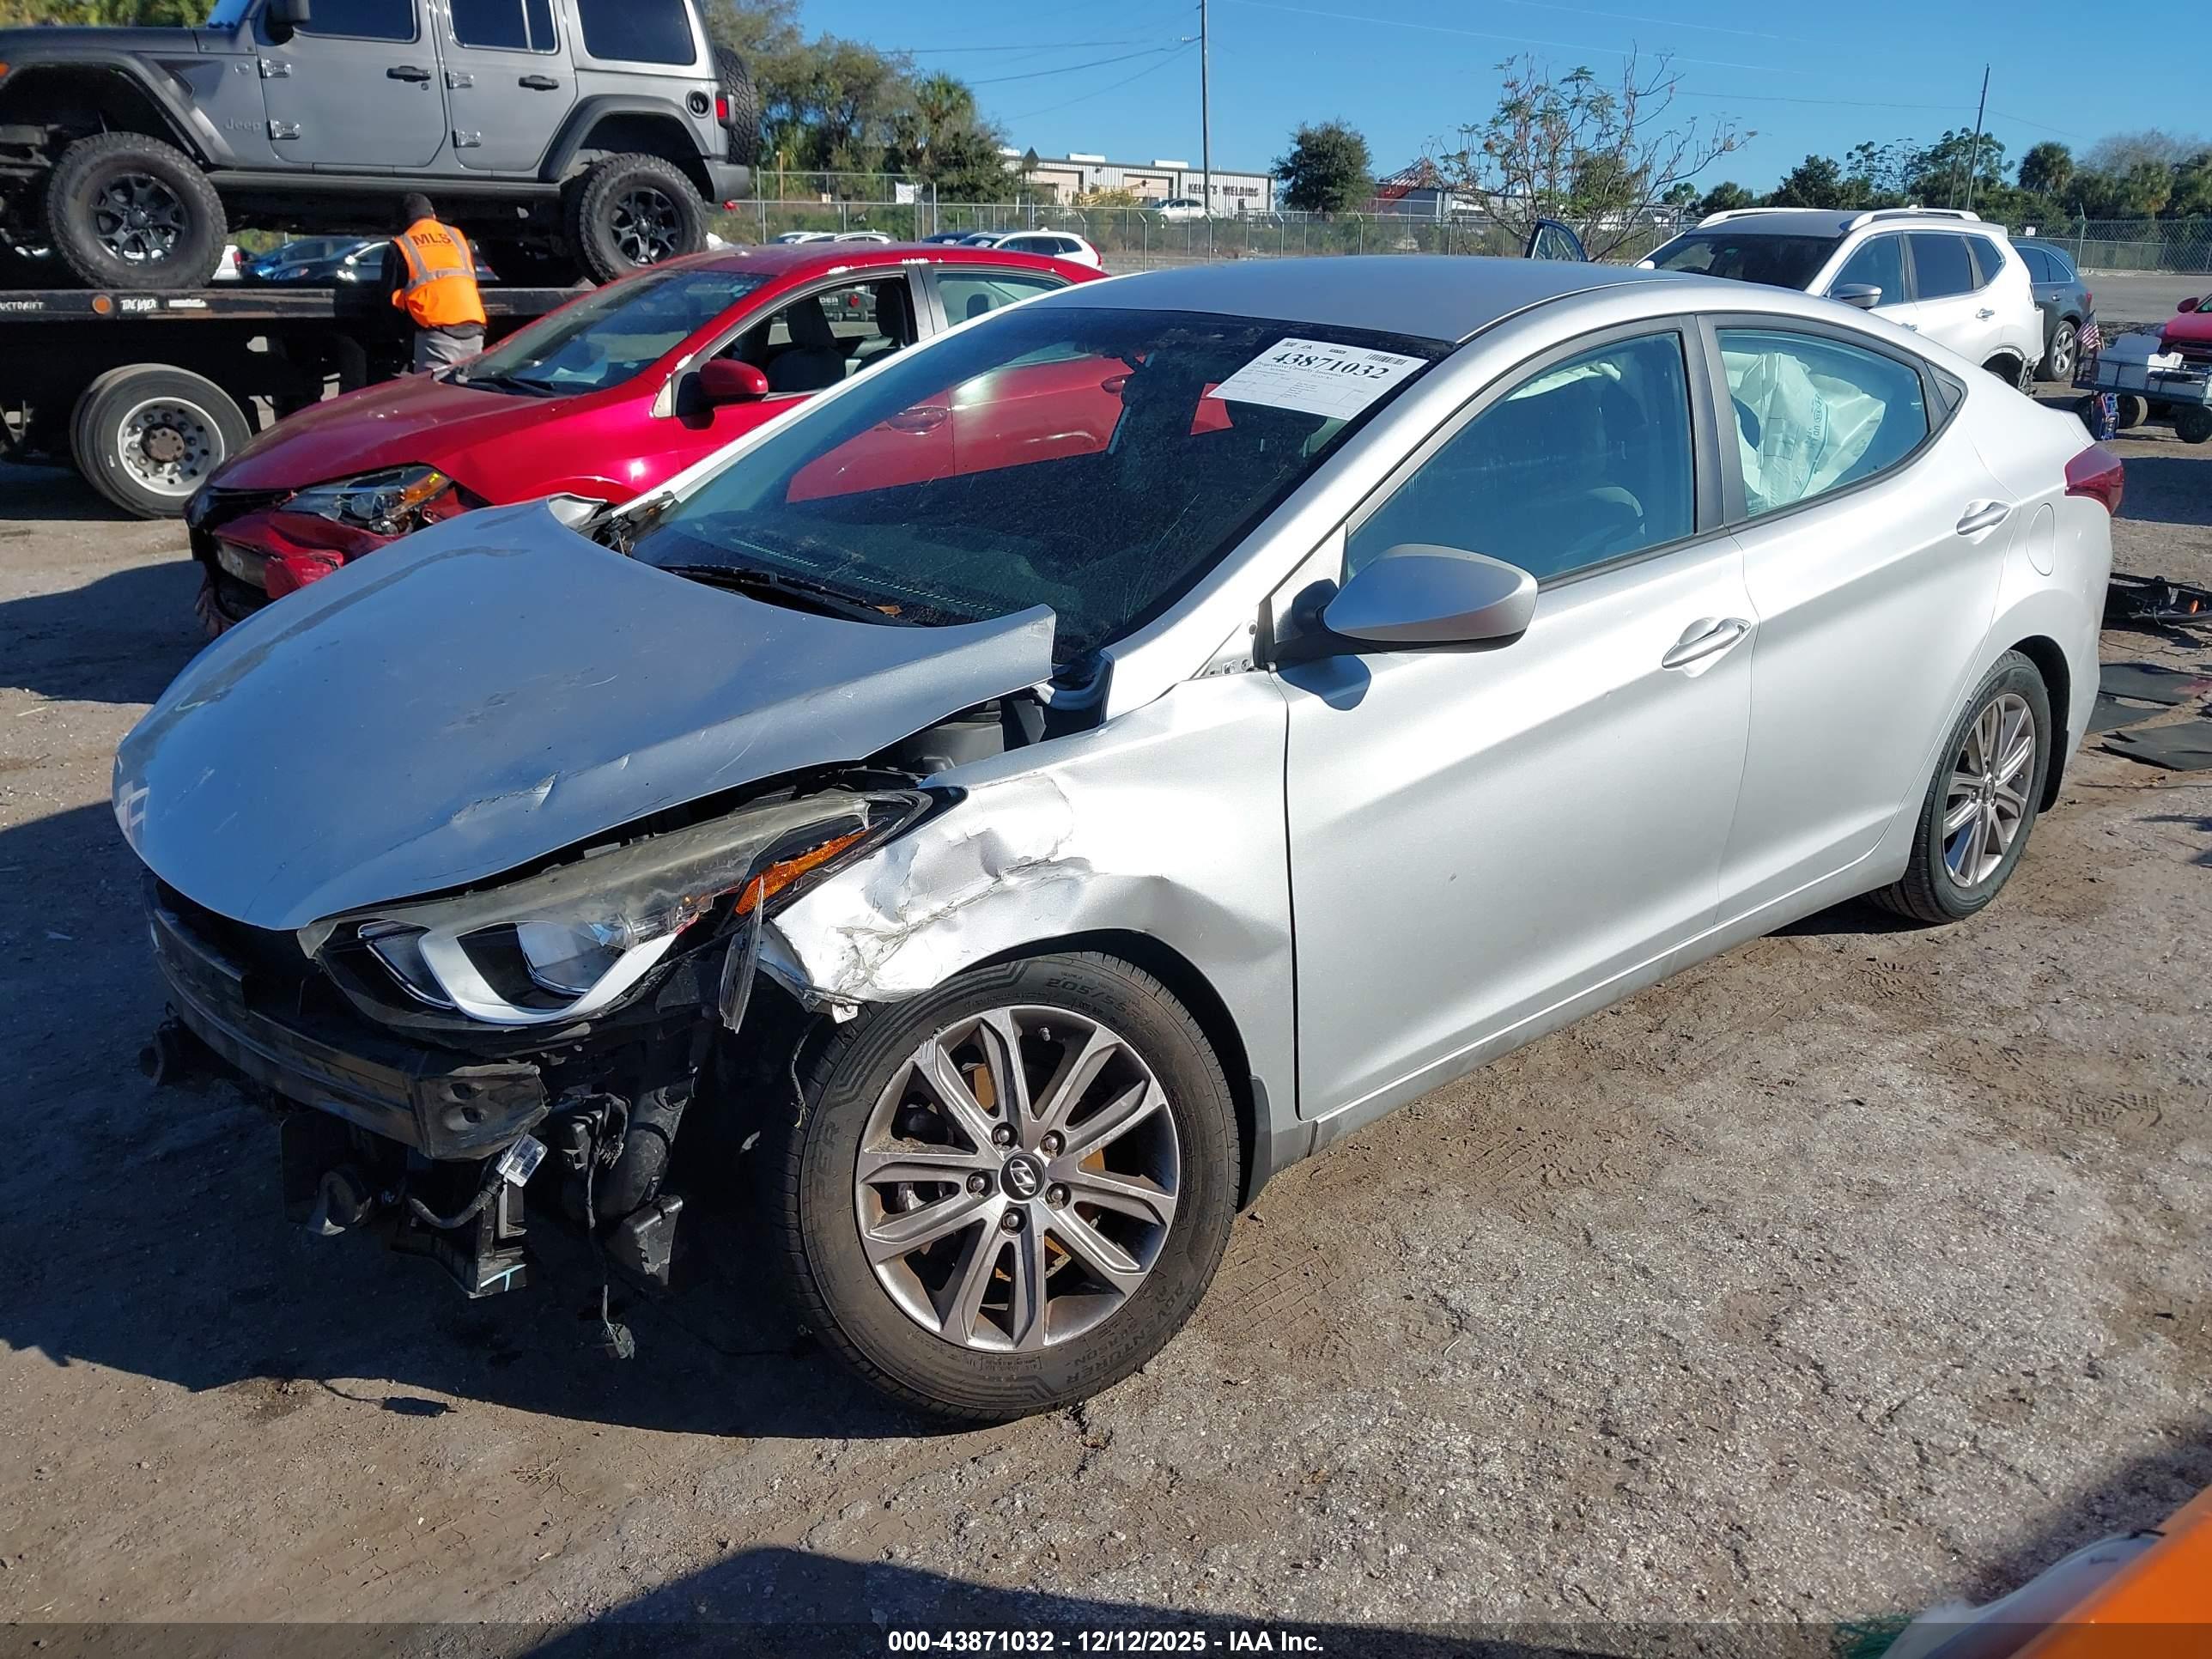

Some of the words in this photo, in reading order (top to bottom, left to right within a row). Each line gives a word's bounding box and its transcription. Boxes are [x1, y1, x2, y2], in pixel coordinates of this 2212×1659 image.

[1222, 185, 1259, 197] WELDING
[411, 233, 452, 246] MLS
[1272, 352, 1389, 379] 43871032
